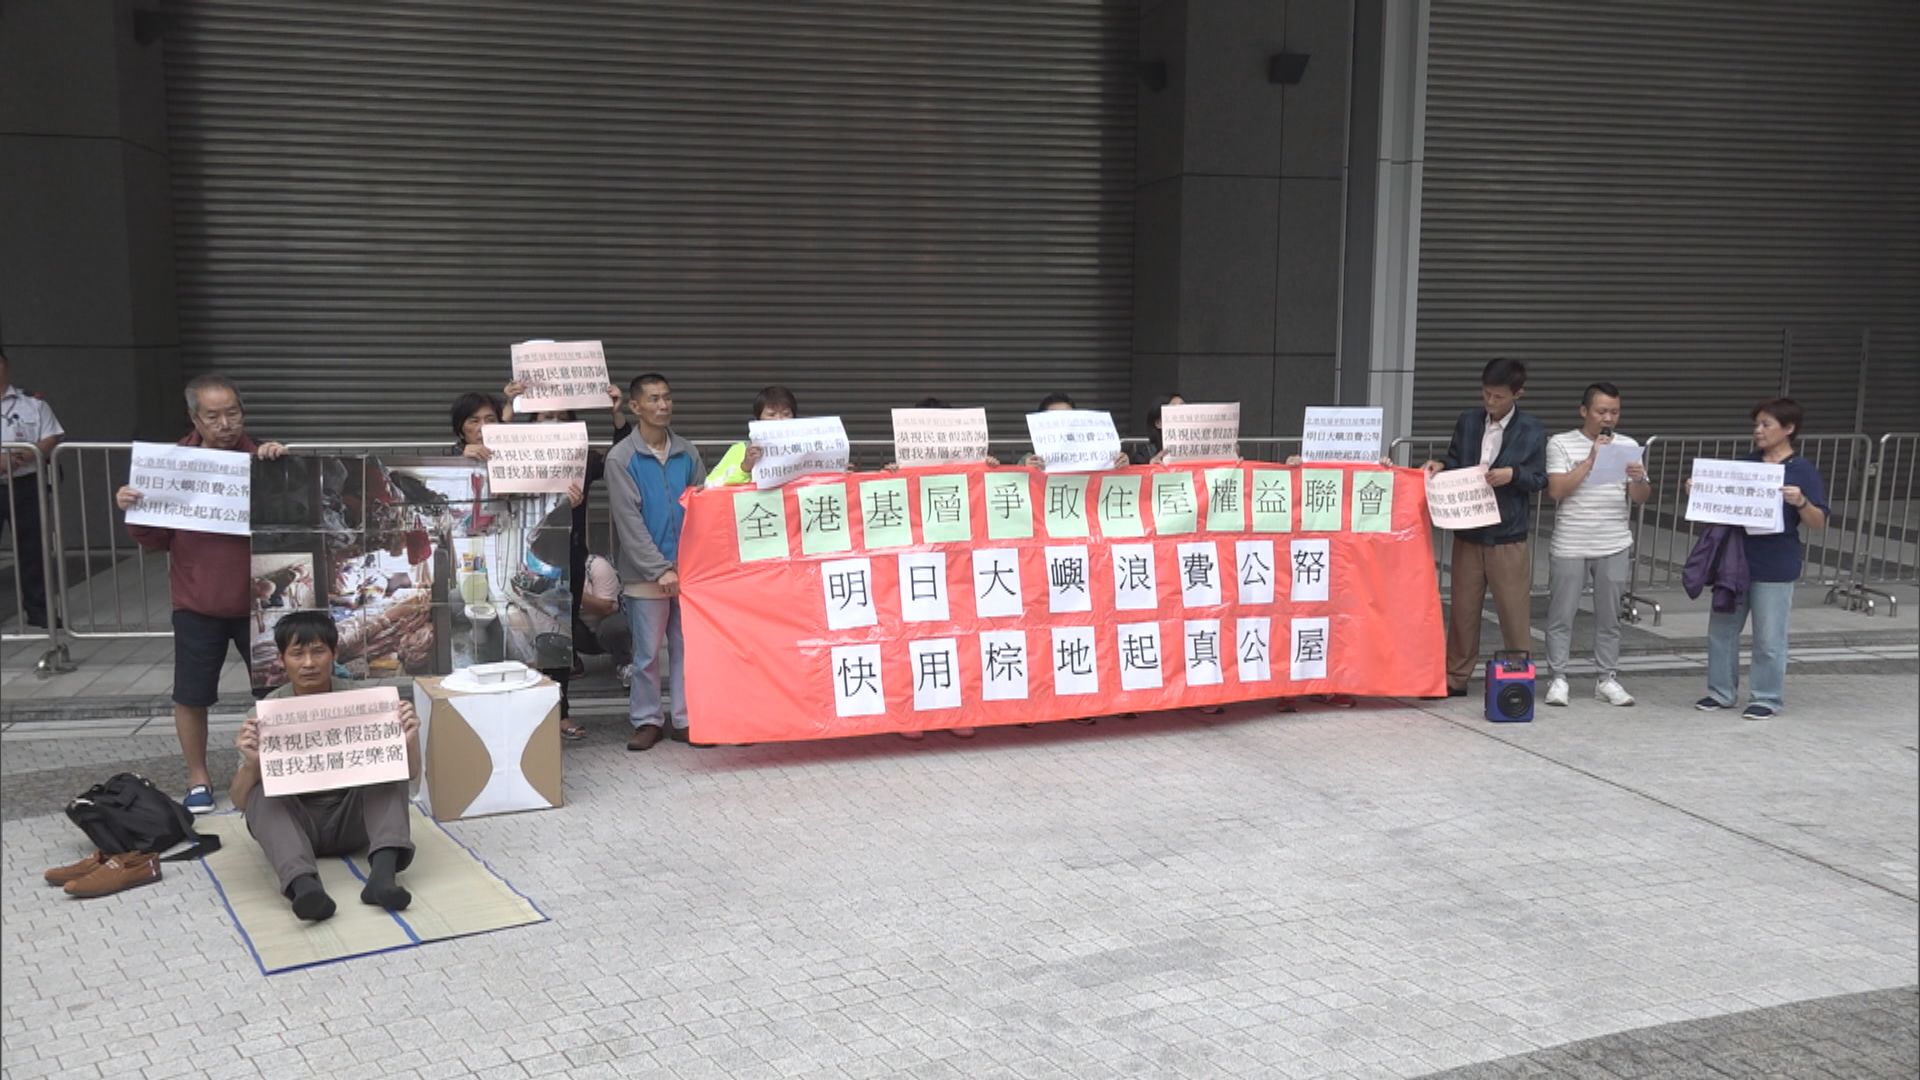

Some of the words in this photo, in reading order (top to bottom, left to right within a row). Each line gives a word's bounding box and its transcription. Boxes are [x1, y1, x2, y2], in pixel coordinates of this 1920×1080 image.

[740, 478, 1387, 541] 全港基層爭取住屋權益聯會
[829, 550, 1325, 610] 明日大嶼浪費公帑
[838, 628, 1324, 697] 快用棕地起真公屋
[266, 745, 403, 777] 還我基層安樂窩
